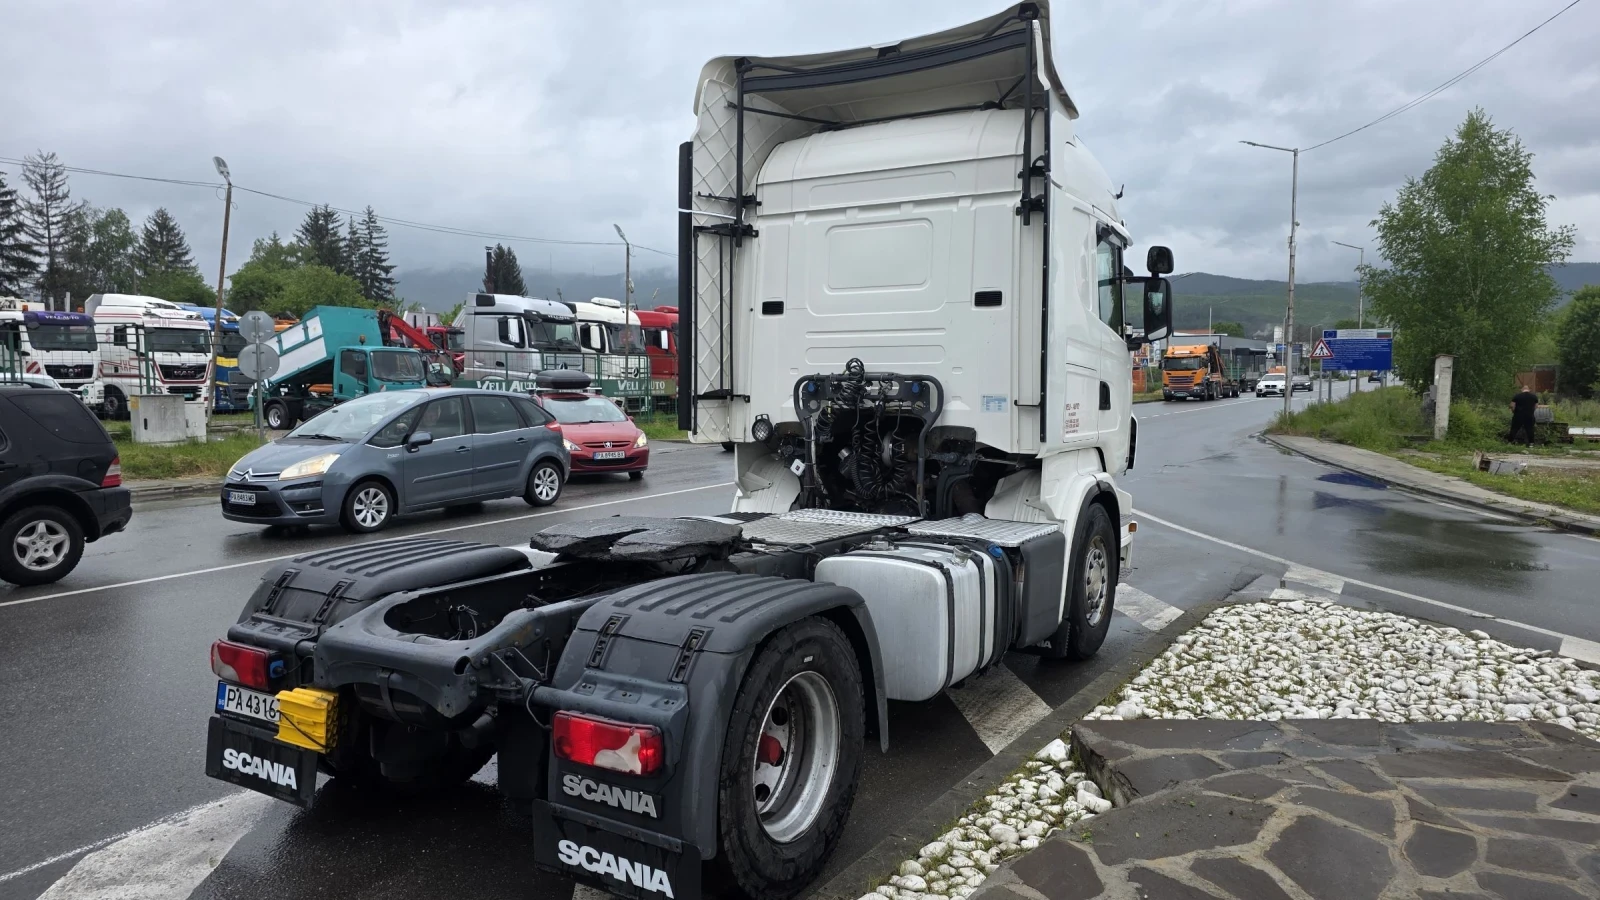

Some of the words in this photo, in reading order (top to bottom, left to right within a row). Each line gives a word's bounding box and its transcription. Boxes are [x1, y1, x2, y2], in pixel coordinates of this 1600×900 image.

[617, 380, 639, 391] VELI
[226, 688, 243, 711] PA
[245, 694, 277, 719] 4316
[222, 748, 297, 790] SCANIA
[562, 774, 658, 819] SCANIA
[557, 839, 675, 900] SCANIA
